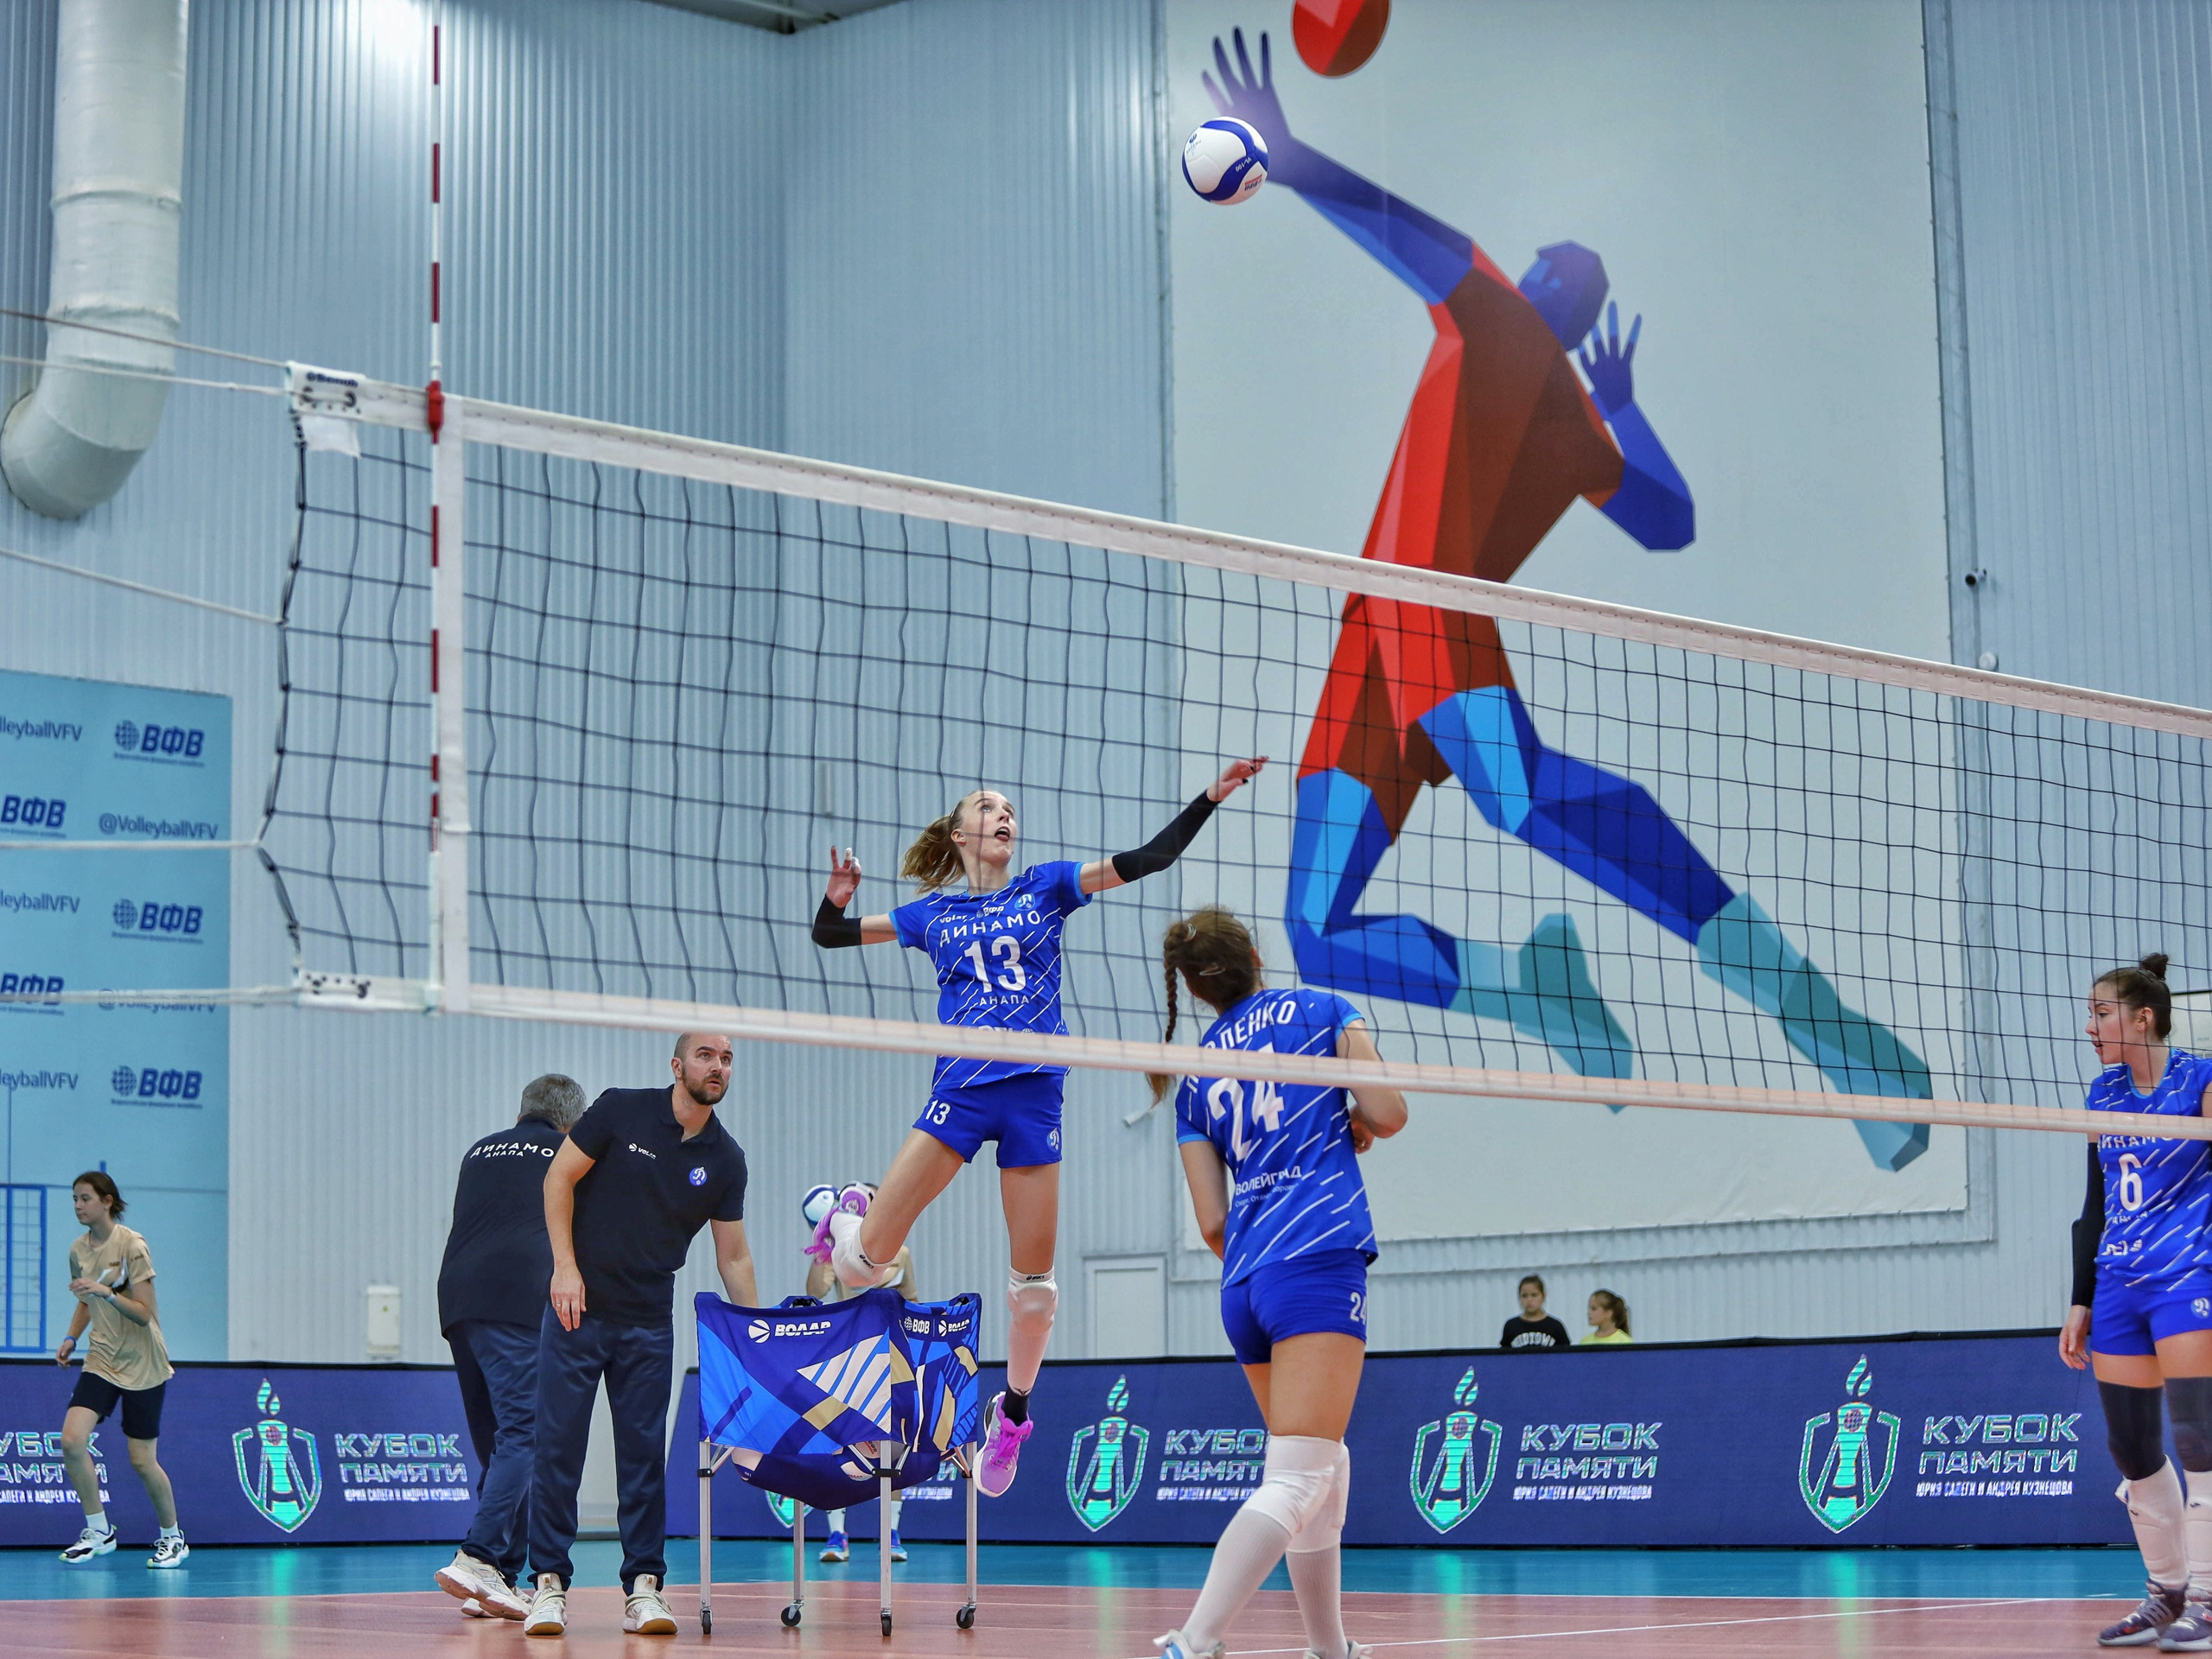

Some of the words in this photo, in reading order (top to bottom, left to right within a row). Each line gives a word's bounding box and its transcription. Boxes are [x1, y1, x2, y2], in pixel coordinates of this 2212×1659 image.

[142, 723, 205, 758] ВФВ
[1, 795, 67, 828] ВФВ
[99, 813, 218, 842] @VolleyballVFV
[140, 901, 203, 934] ВФВ
[939, 910, 1040, 948] ДИНАМО
[963, 935, 1027, 994] 13
[979, 995, 1030, 1007] АНАПА
[138, 1067, 203, 1100] ВФВ
[925, 1099, 950, 1125] 13
[1207, 1041, 1285, 1161] 24
[470, 1142, 554, 1159] ДИНАМО
[485, 1150, 524, 1159] АНАПА
[2118, 1152, 2143, 1211] 6
[1350, 1291, 1366, 1325] 24
[912, 1319, 931, 1335] ВФВ
[1163, 1428, 1270, 1455] КУБО
[1520, 1422, 1663, 1452] КУБОК
[1923, 1413, 2082, 1445] КУБОК
[334, 1433, 464, 1459] КУБОК
[339, 1462, 468, 1484] ПАМЯТИ
[1159, 1459, 1265, 1481] ПАМЯТ
[1516, 1456, 1658, 1479] ПАМЯТИ
[1918, 1448, 2078, 1475] ПАМЯТИ
